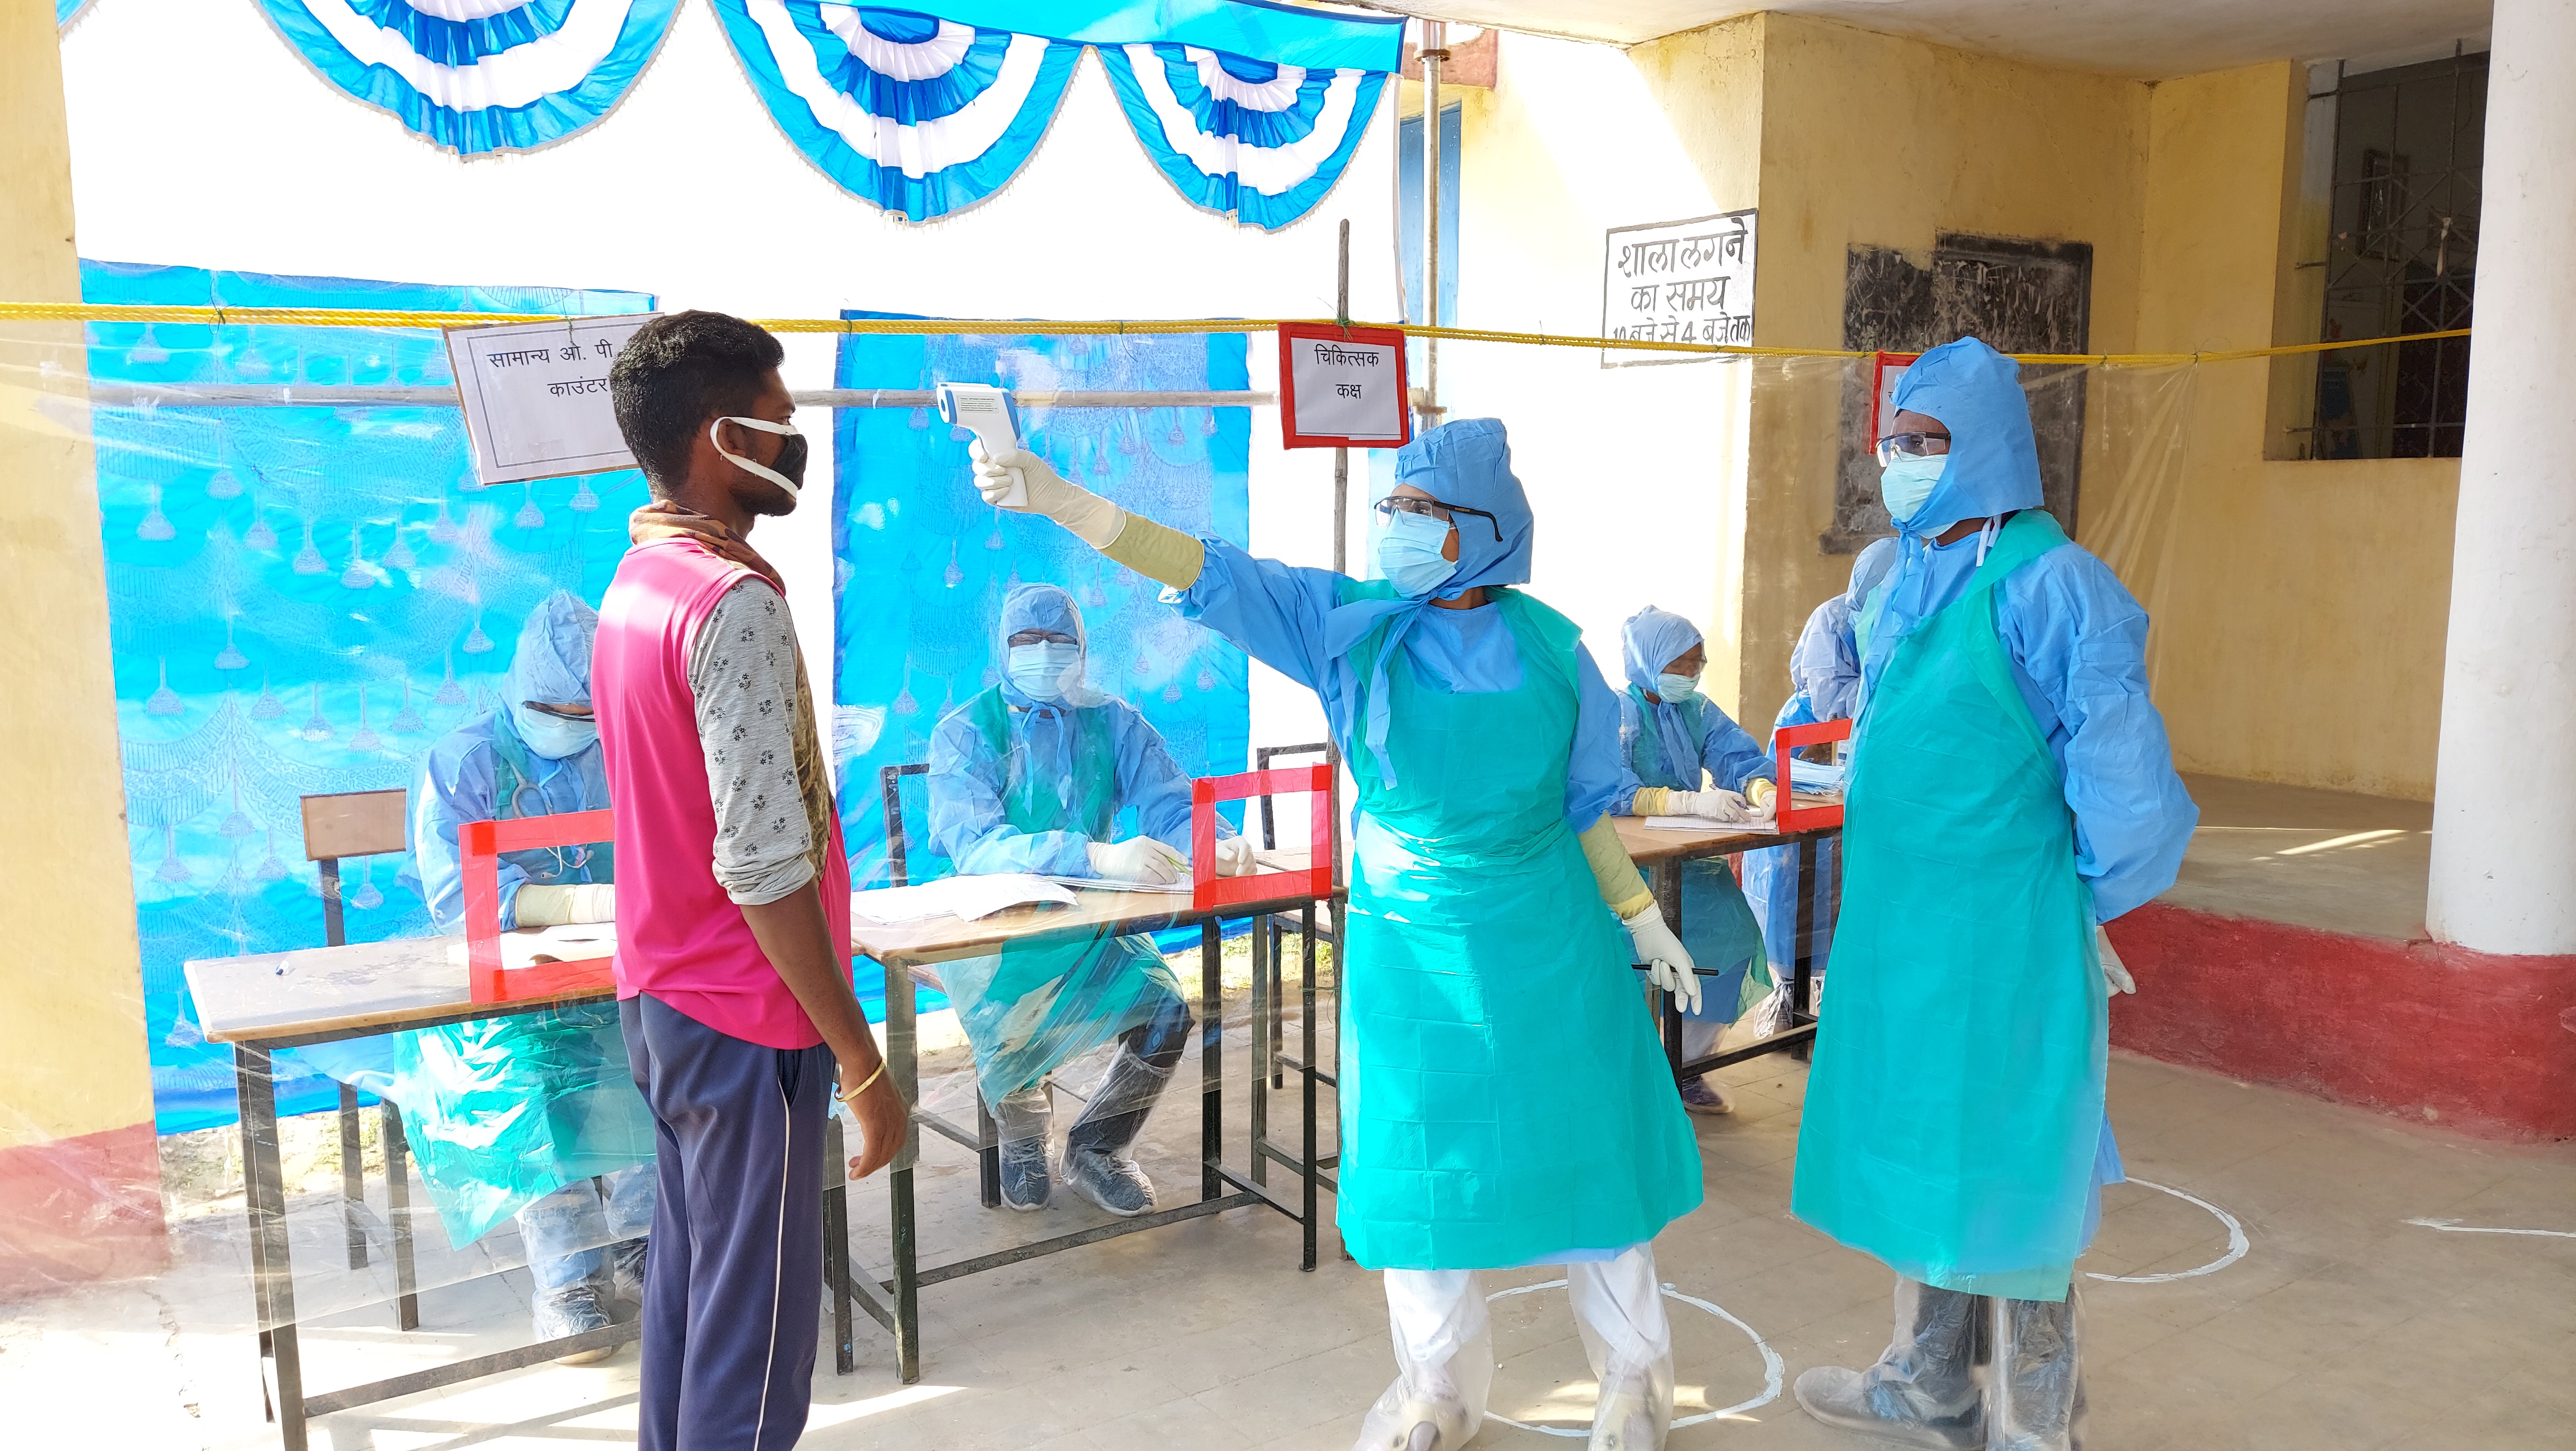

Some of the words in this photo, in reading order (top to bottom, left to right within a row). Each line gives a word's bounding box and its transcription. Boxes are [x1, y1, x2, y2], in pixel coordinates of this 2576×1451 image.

[1618, 239, 1680, 277] शाला
[1681, 217, 1748, 269] लगने
[1631, 285, 1660, 313] का
[1666, 276, 1731, 312] समय
[1660, 315, 1680, 343] से
[487, 349, 550, 368] सामान्य
[1314, 343, 1379, 367] चिकित्सक
[547, 376, 608, 397] काउंटर
[1335, 384, 1362, 399] कक्ष
